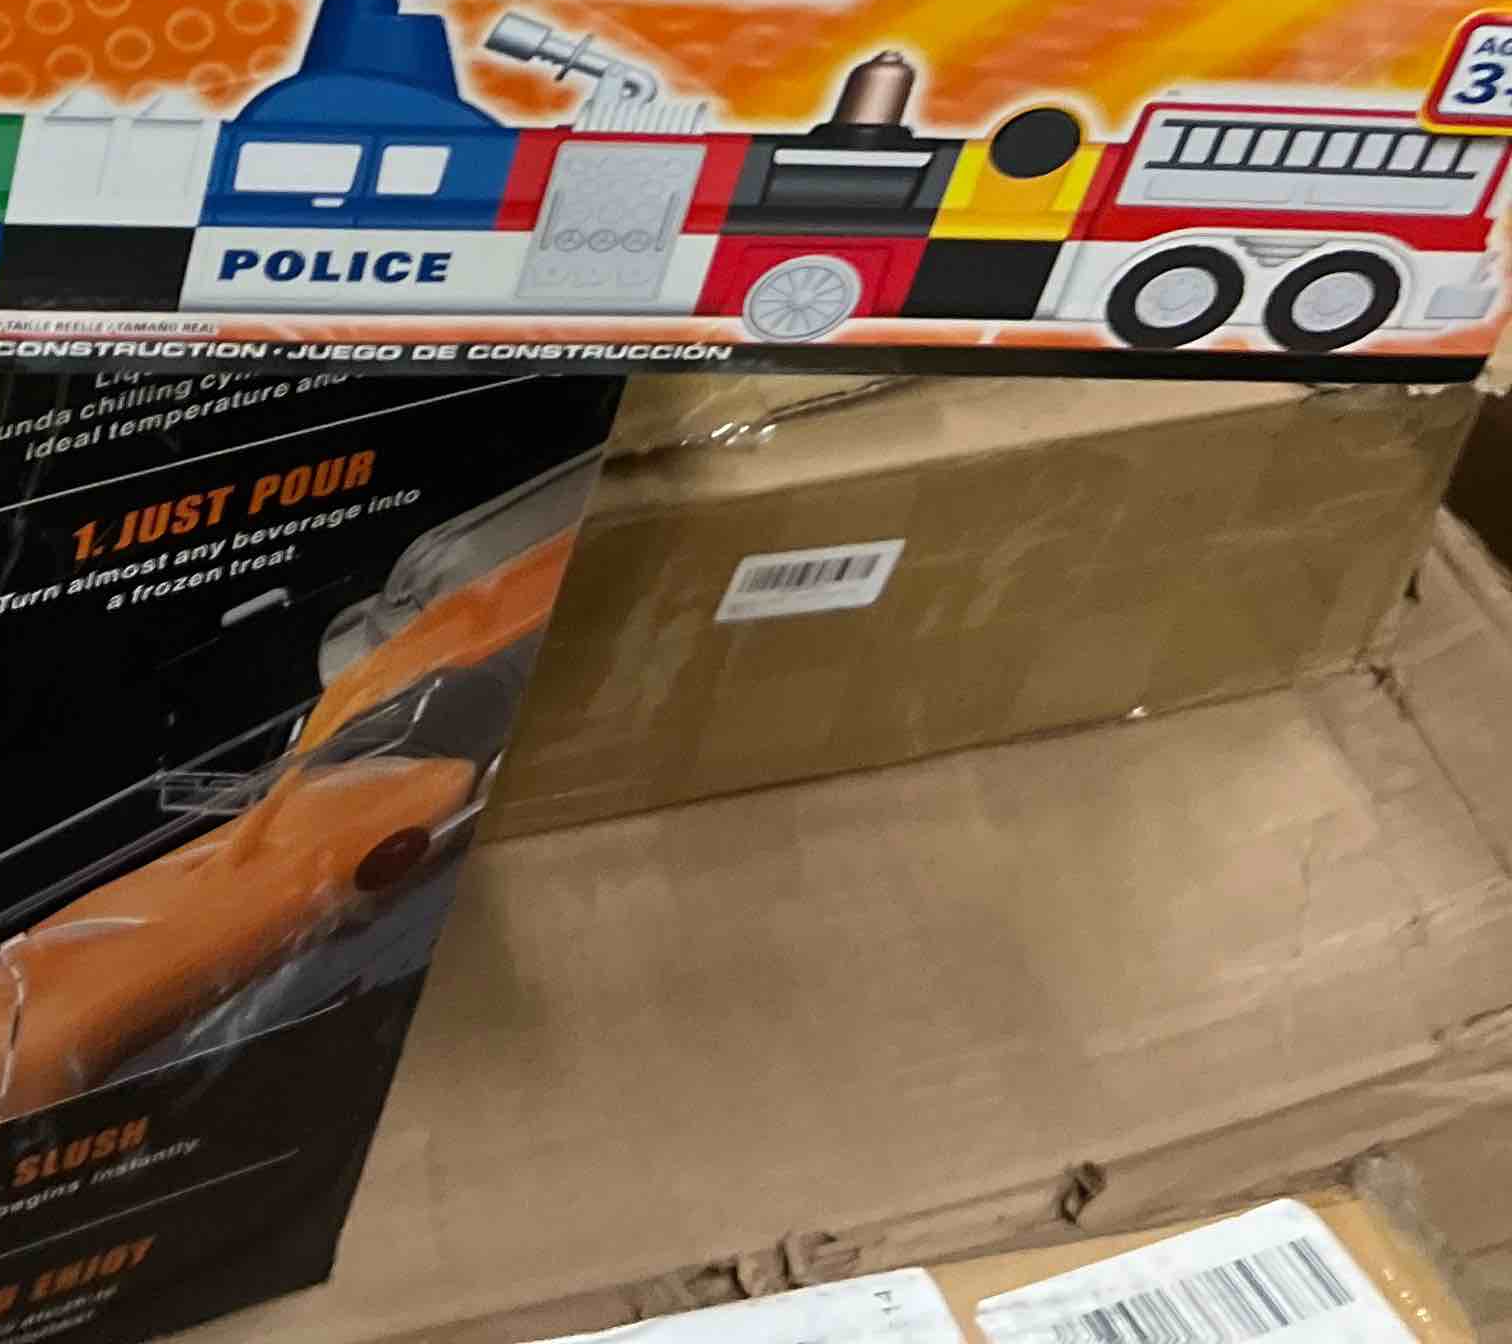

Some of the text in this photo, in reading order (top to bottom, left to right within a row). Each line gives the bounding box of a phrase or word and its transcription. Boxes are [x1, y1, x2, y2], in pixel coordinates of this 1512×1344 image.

[217, 249, 454, 284] POLICE
[287, 342, 397, 362] JUEGO
[411, 343, 461, 362] DE
[467, 341, 735, 363] CONSTRUCCIÓN
[24, 427, 100, 462] ideal
[108, 382, 289, 442] temperature
[79, 378, 194, 422] chilling
[112, 484, 238, 552] JUST
[247, 449, 377, 515] POUR
[67, 553, 170, 596] almost
[174, 538, 227, 566] any
[231, 505, 362, 551] beverage
[368, 487, 421, 513] into
[105, 594, 124, 611] a
[130, 565, 224, 607] frozen
[12, 1115, 151, 1186] SLUSH
[89, 1137, 202, 1186] instantly
